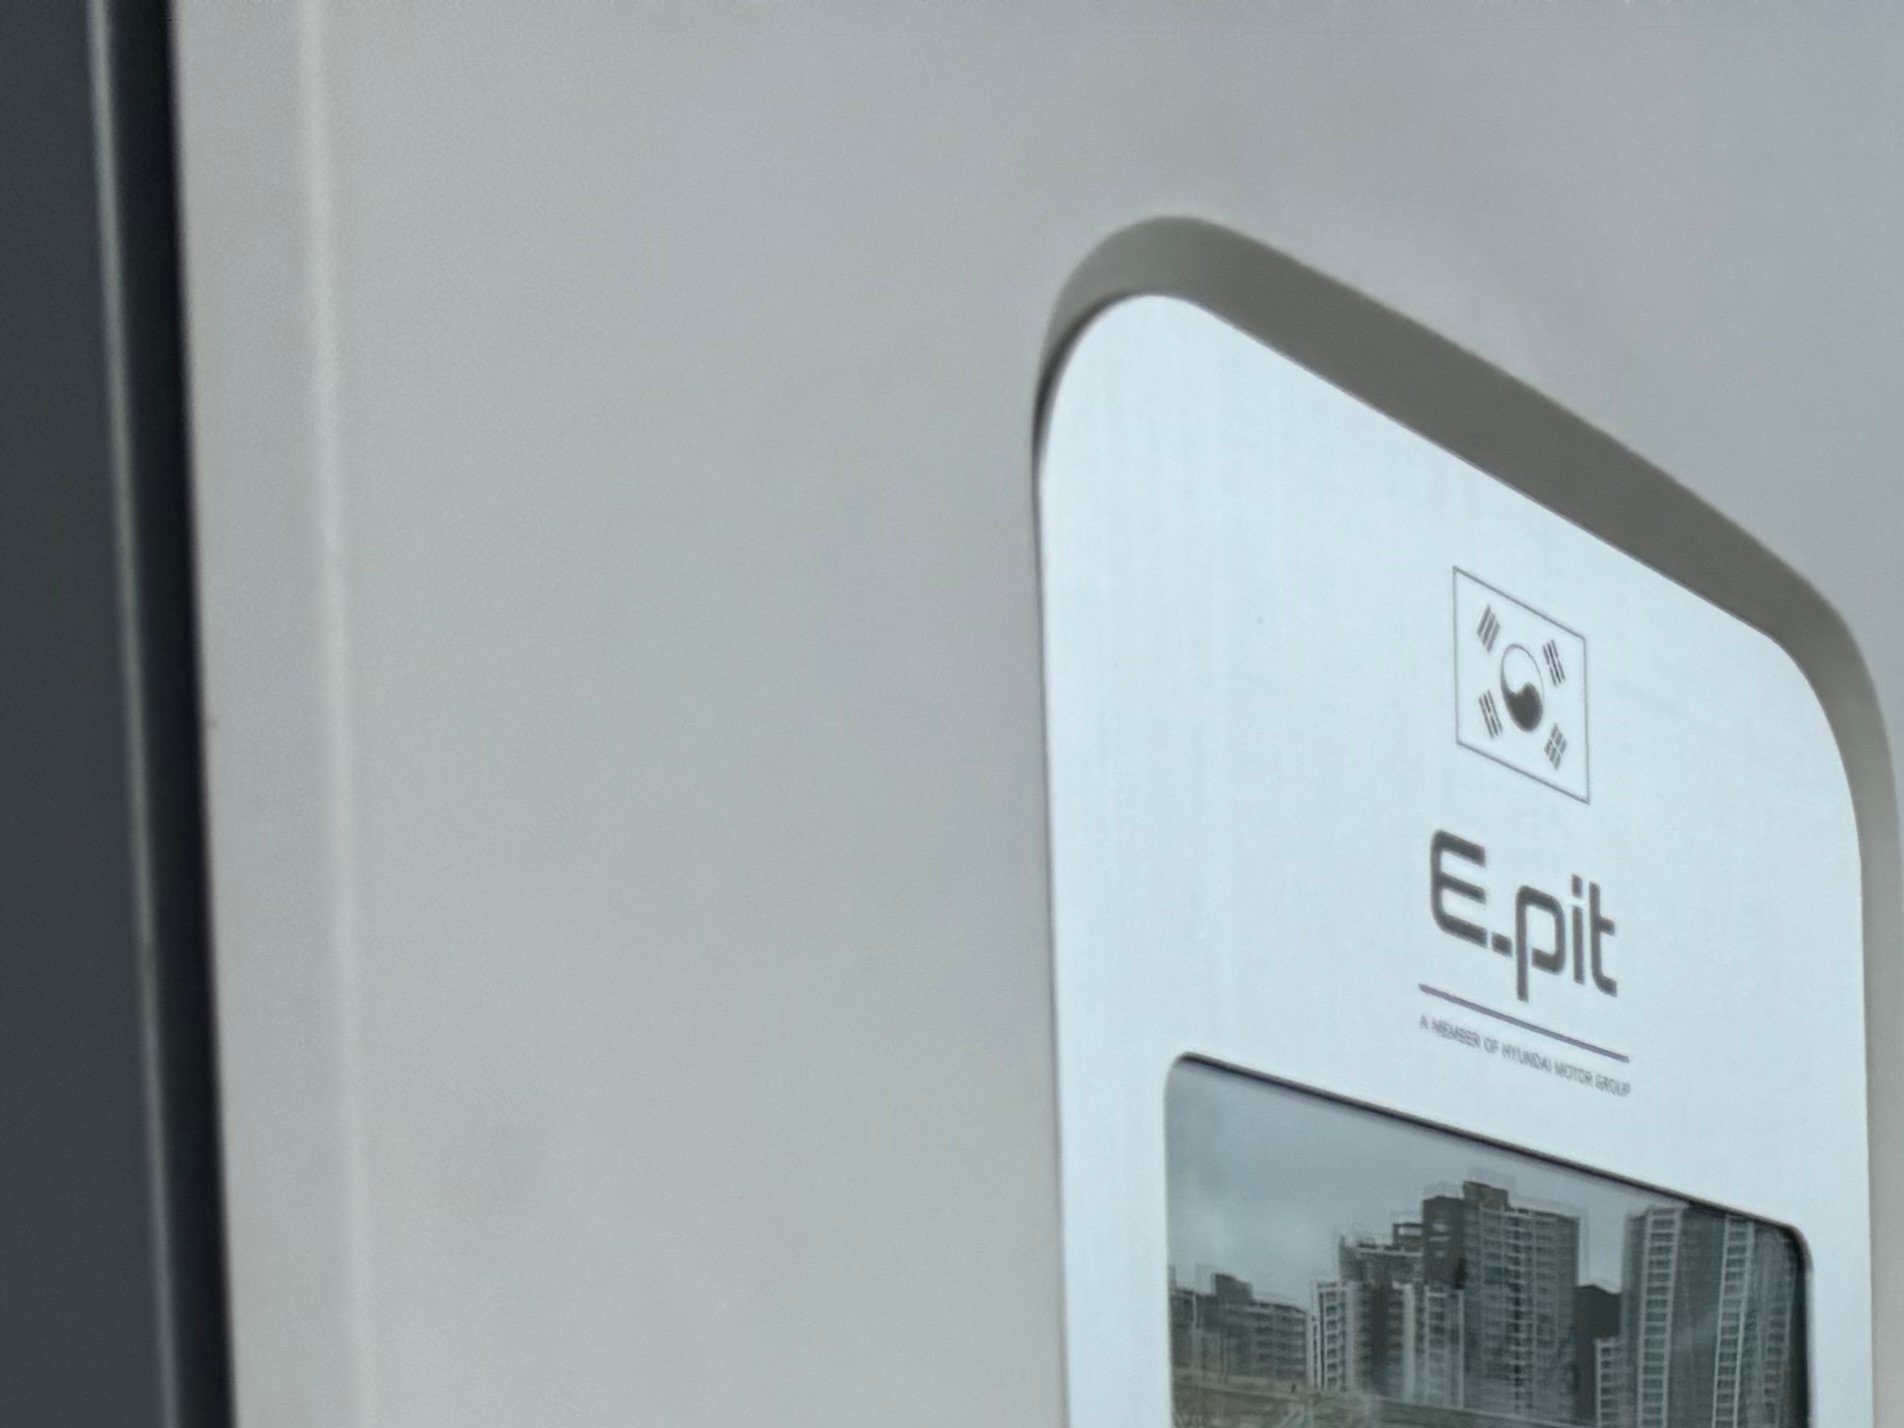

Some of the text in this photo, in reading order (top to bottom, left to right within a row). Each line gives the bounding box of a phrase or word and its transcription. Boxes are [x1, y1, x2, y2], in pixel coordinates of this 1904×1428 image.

[1431, 828, 1617, 1002] E.pit
[1419, 1012, 1429, 1030] A
[1431, 1018, 1481, 1049] MEMBER
[1502, 1043, 1552, 1074] HYUNDAI
[1554, 1060, 1593, 1088] MOTOR
[1595, 1074, 1632, 1098] GROUP
